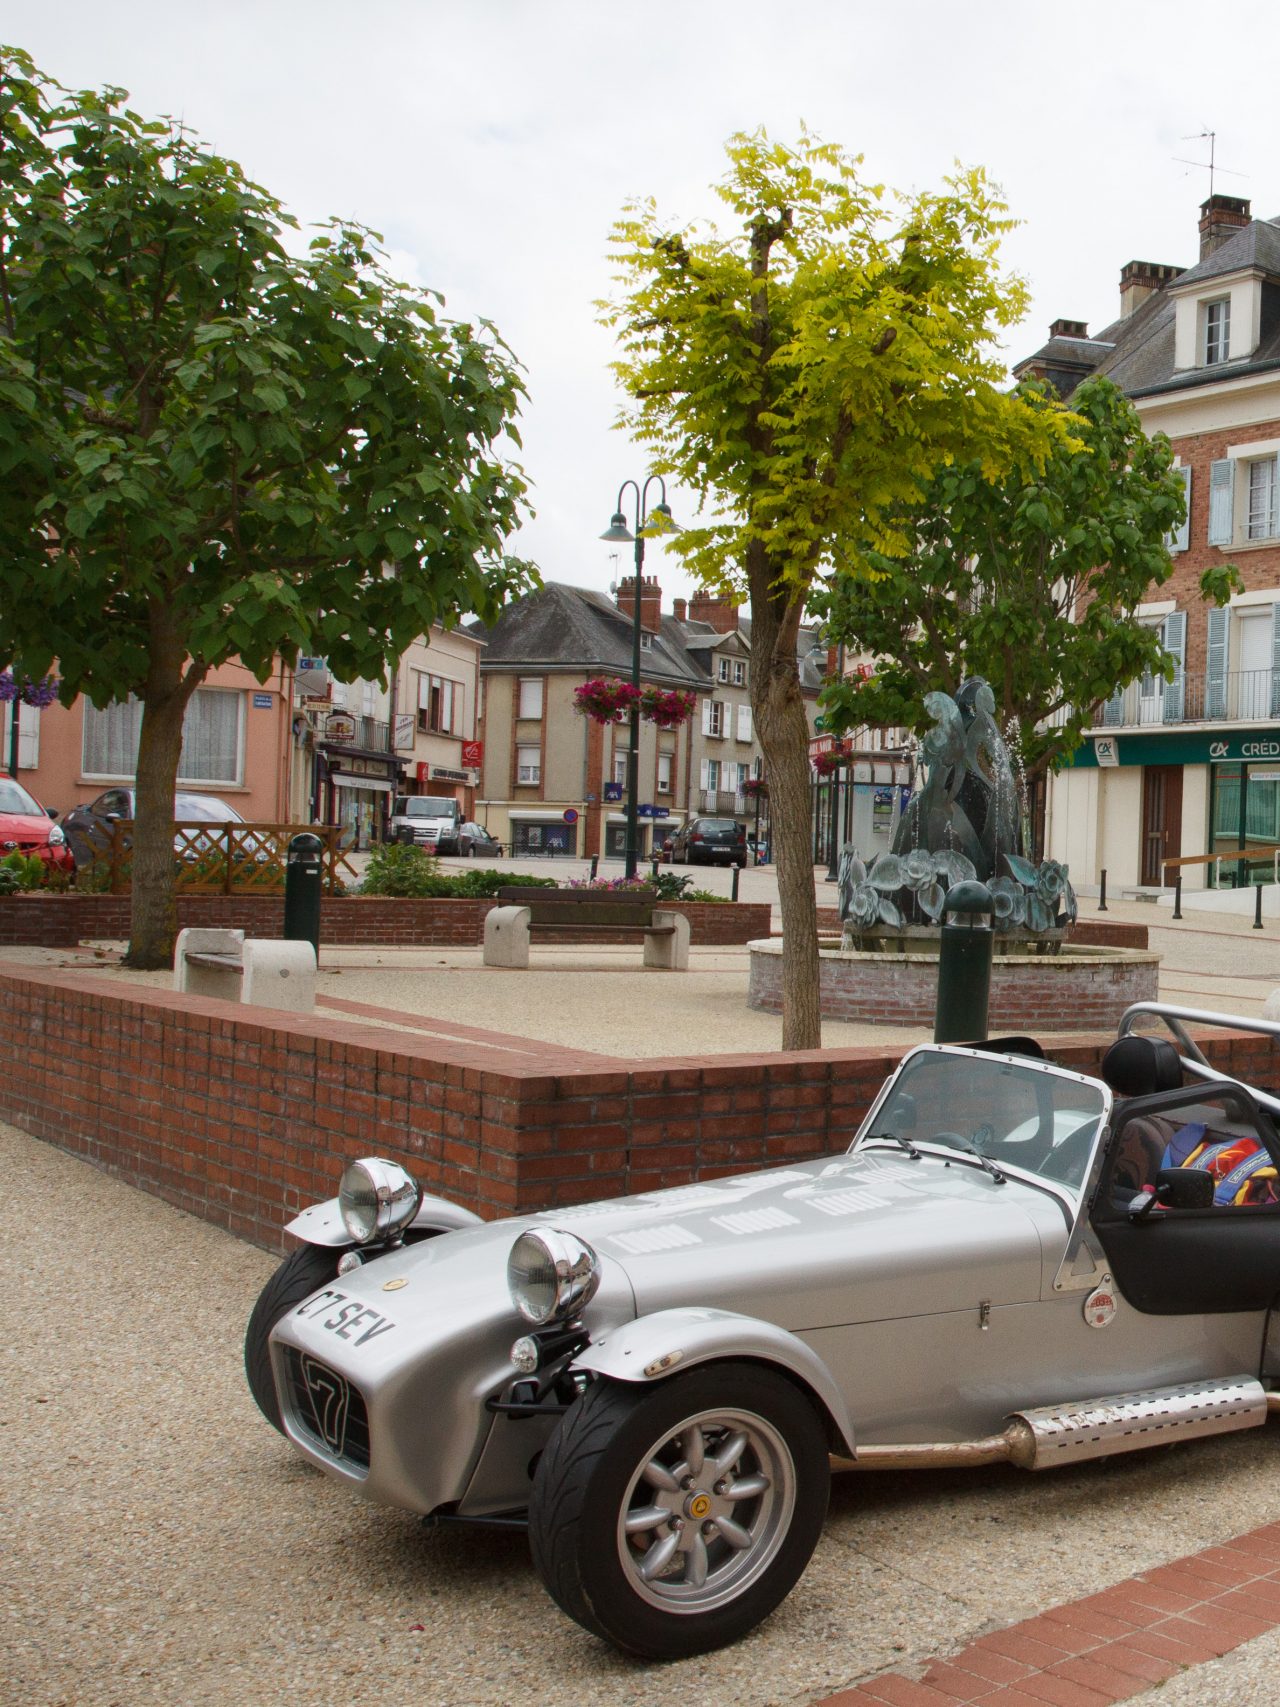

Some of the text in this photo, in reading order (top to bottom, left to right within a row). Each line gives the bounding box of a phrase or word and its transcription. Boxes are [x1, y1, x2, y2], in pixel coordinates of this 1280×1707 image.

[297, 1290, 396, 1348] C7 SEV
[306, 1360, 345, 1445] 7
